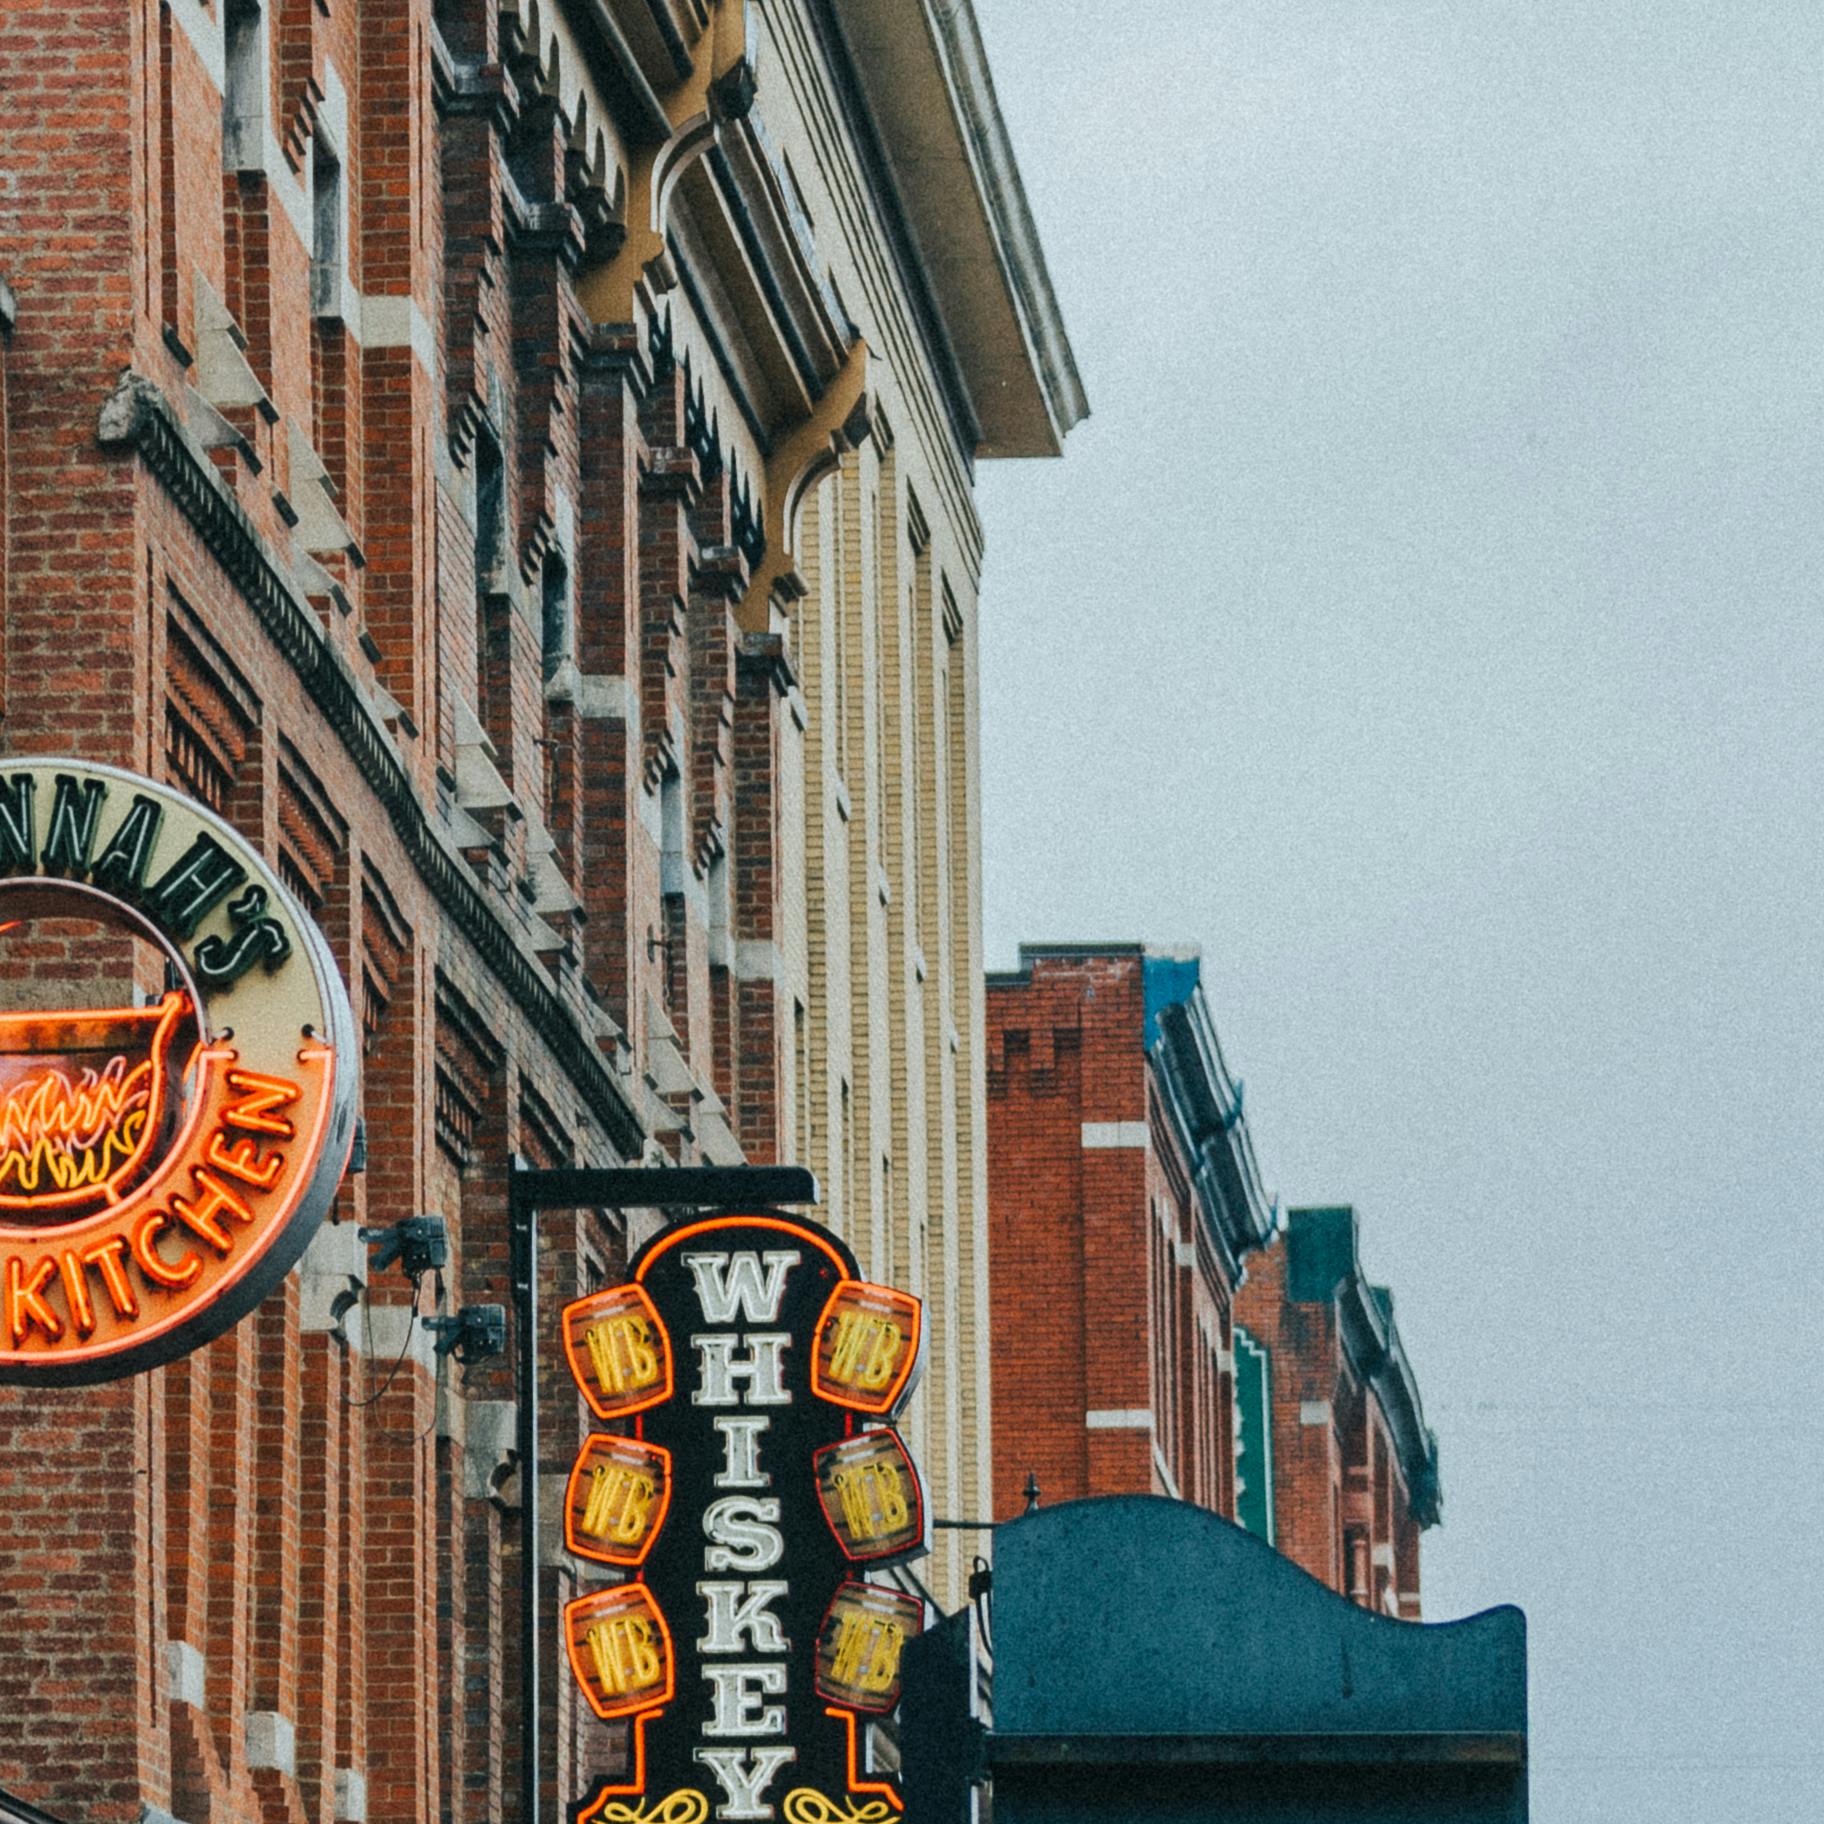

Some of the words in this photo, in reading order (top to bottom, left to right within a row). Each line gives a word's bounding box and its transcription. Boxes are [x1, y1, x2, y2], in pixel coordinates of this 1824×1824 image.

[5, 1071, 302, 1347] KITCHEN
[584, 1313, 659, 1395] WB
[582, 1464, 654, 1544] WB
[682, 1250, 800, 1822] WHISKEY
[586, 1614, 660, 1696] WB
